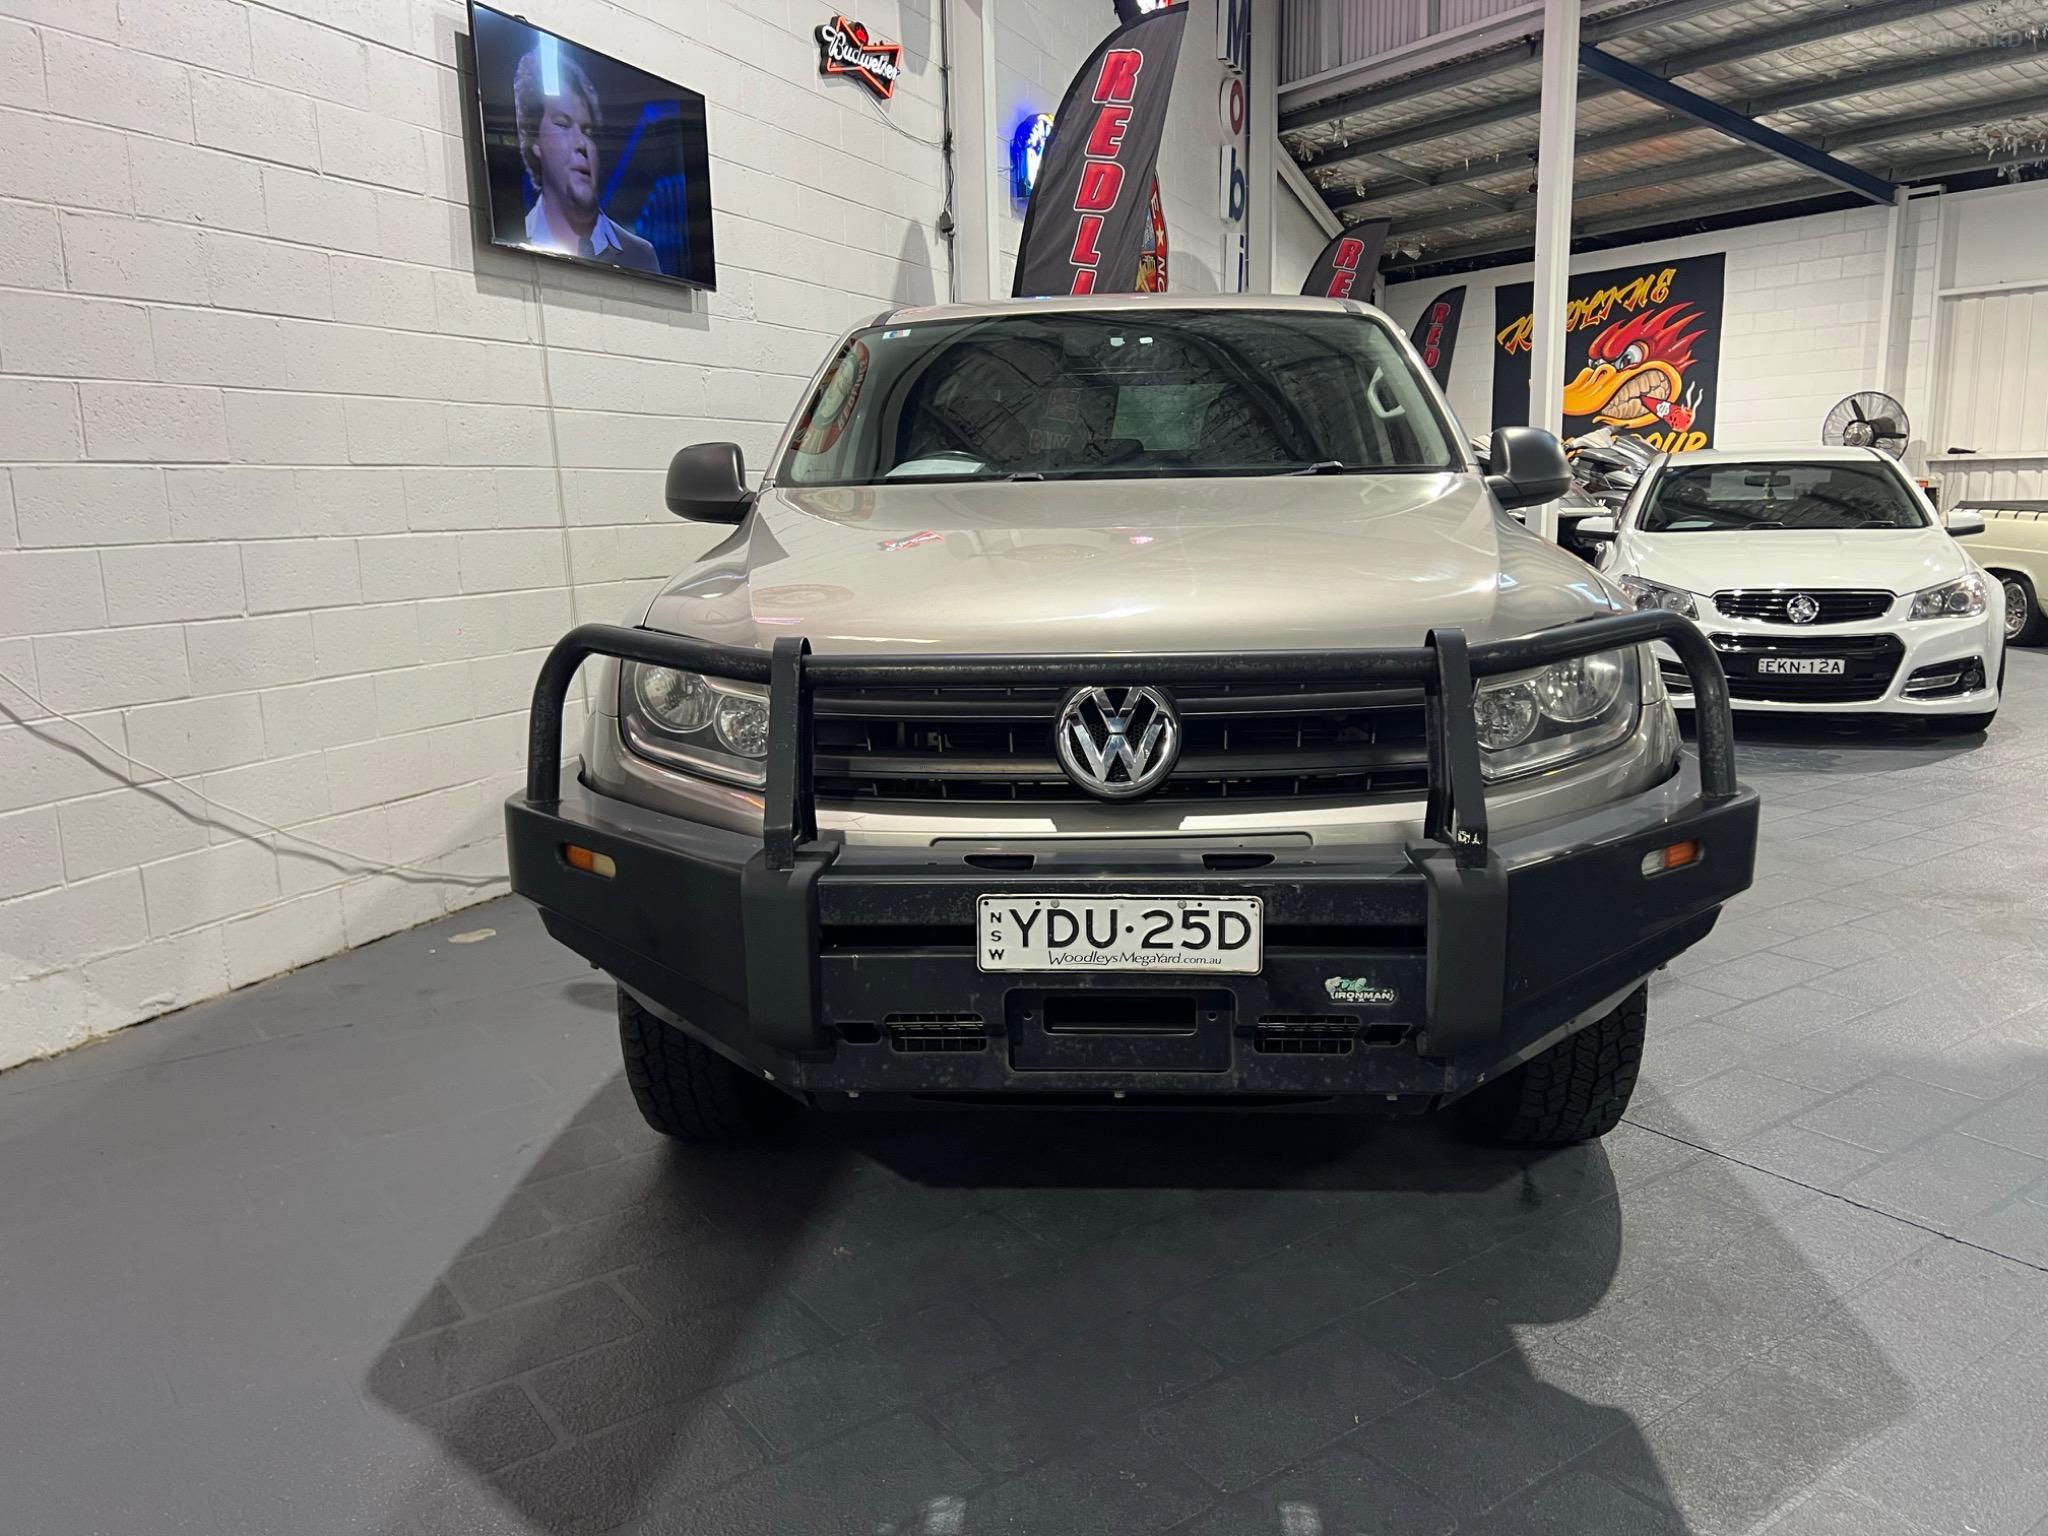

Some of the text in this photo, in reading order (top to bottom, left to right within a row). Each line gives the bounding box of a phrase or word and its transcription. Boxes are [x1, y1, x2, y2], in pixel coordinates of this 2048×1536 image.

[822, 26, 900, 80] Budweiser
[1048, 951, 1222, 966] WoodleysMegaYard.com.au
[1334, 991, 1390, 999] IRONMAN
